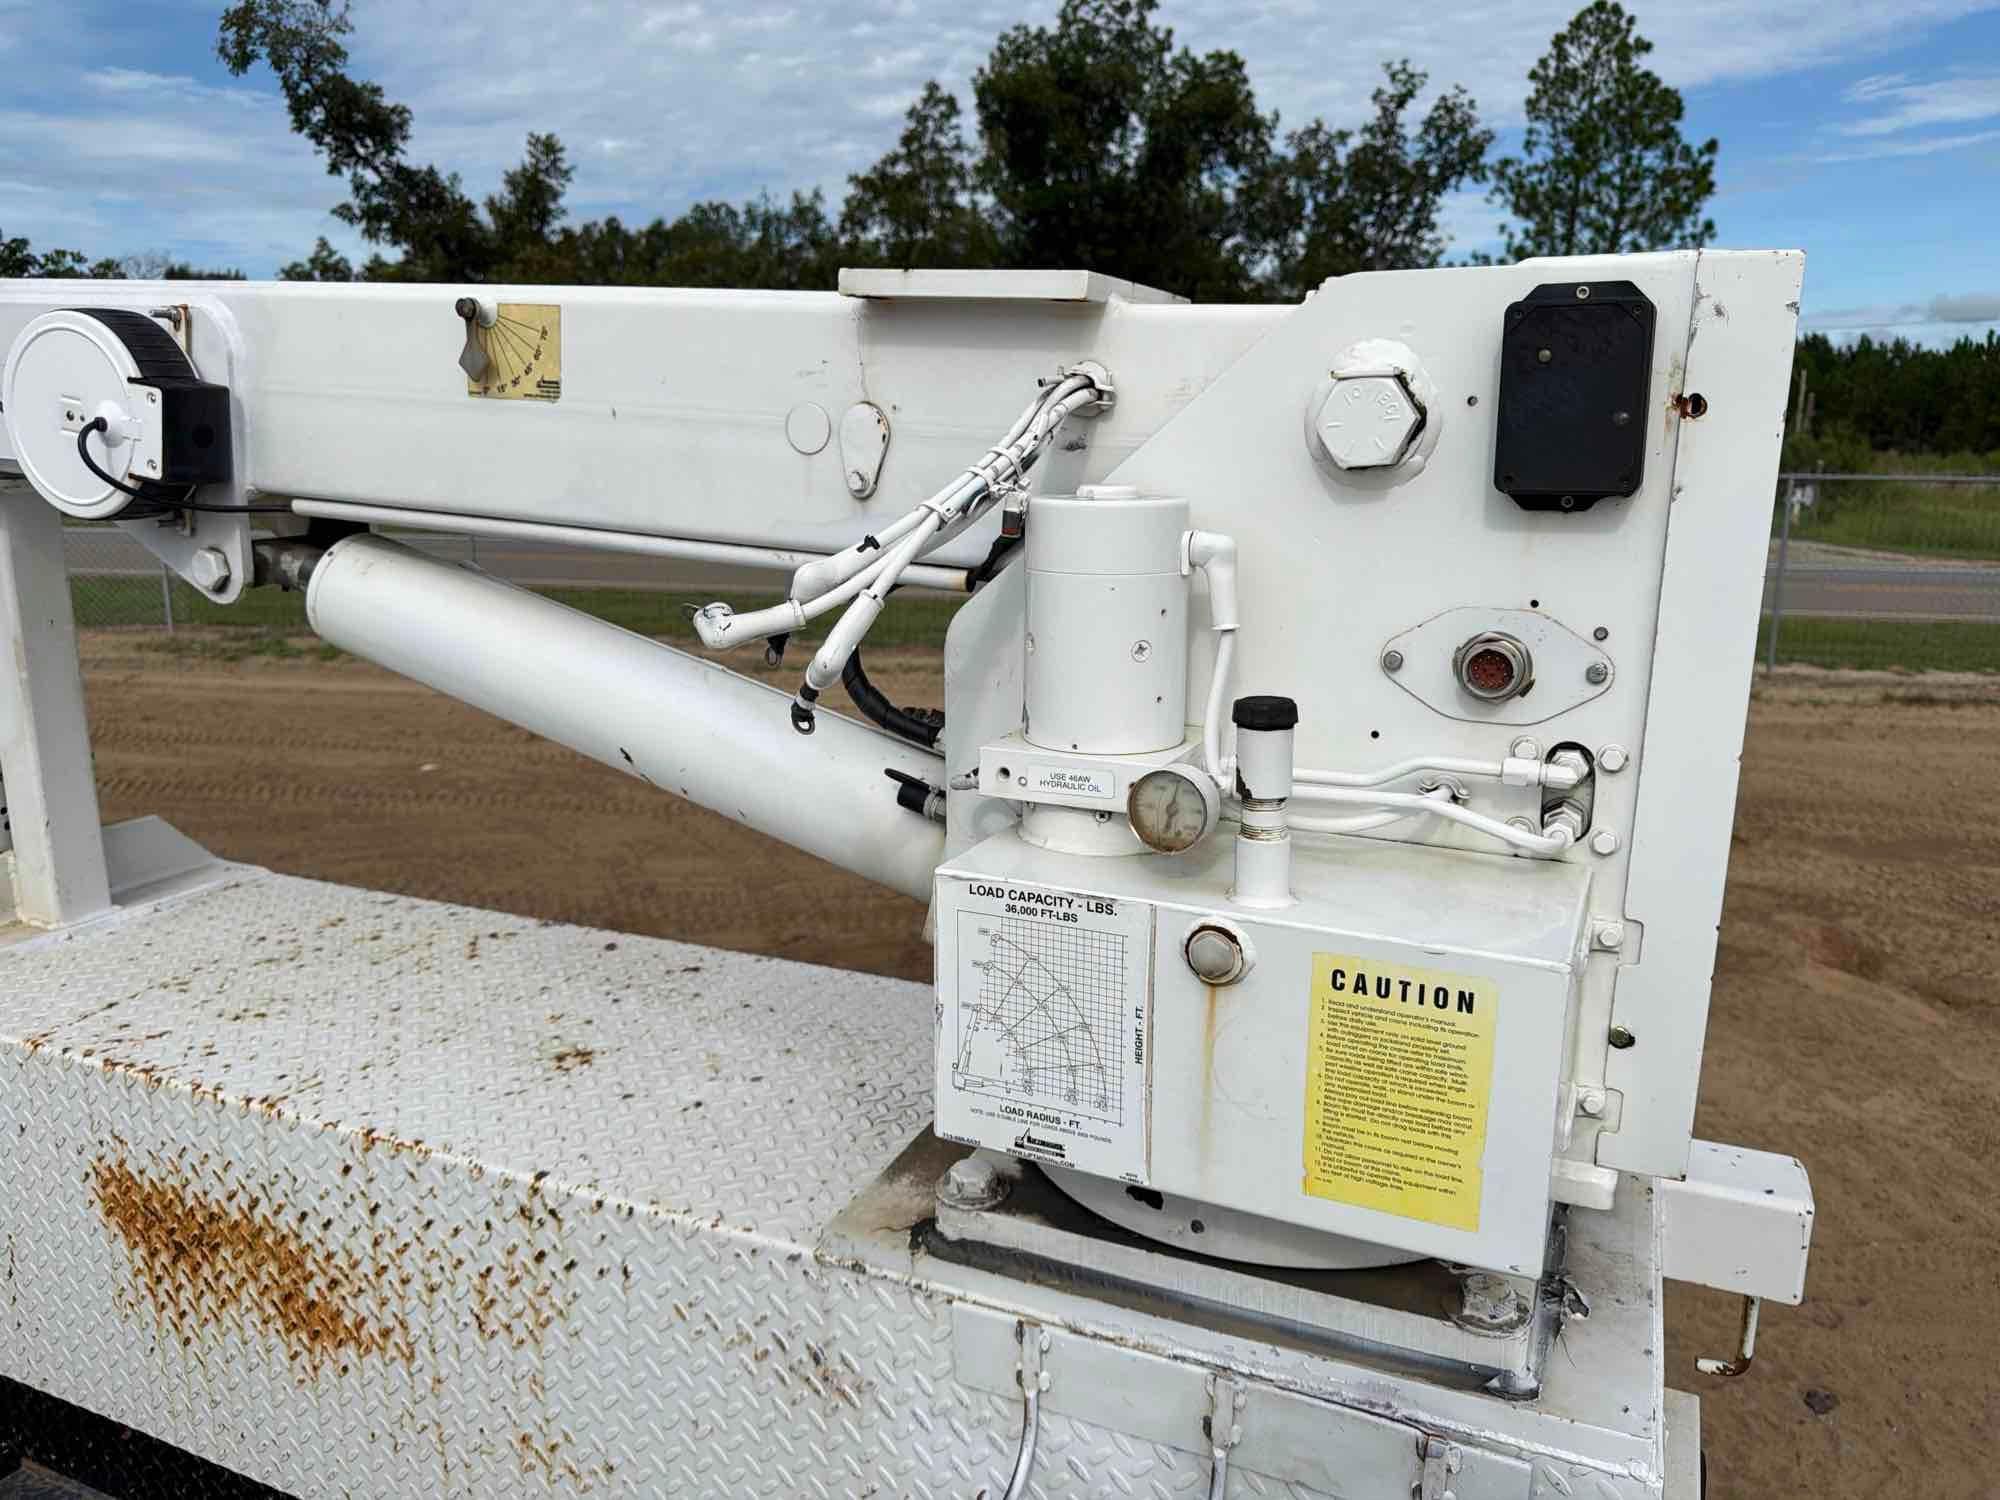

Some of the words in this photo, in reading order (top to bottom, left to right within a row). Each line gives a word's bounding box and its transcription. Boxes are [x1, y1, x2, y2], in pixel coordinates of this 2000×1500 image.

[1040, 779, 1086, 791] HYDRAULIC
[1087, 784, 1102, 792] OIL
[1050, 771, 1067, 781] USE
[969, 883, 1004, 899] LOAD
[1008, 889, 1074, 909] CAPACITY
[1086, 901, 1118, 916] LBS.
[1005, 903, 1038, 917] 36,000
[1040, 908, 1078, 923] FT-LBS
[1331, 968, 1474, 1014] CAUTION
[1135, 1026, 1144, 1065] HEIGHT
[999, 1103, 1024, 1118] LOAD
[1026, 1110, 1061, 1125] RADIUS
[1069, 1119, 1082, 1130] FT.
